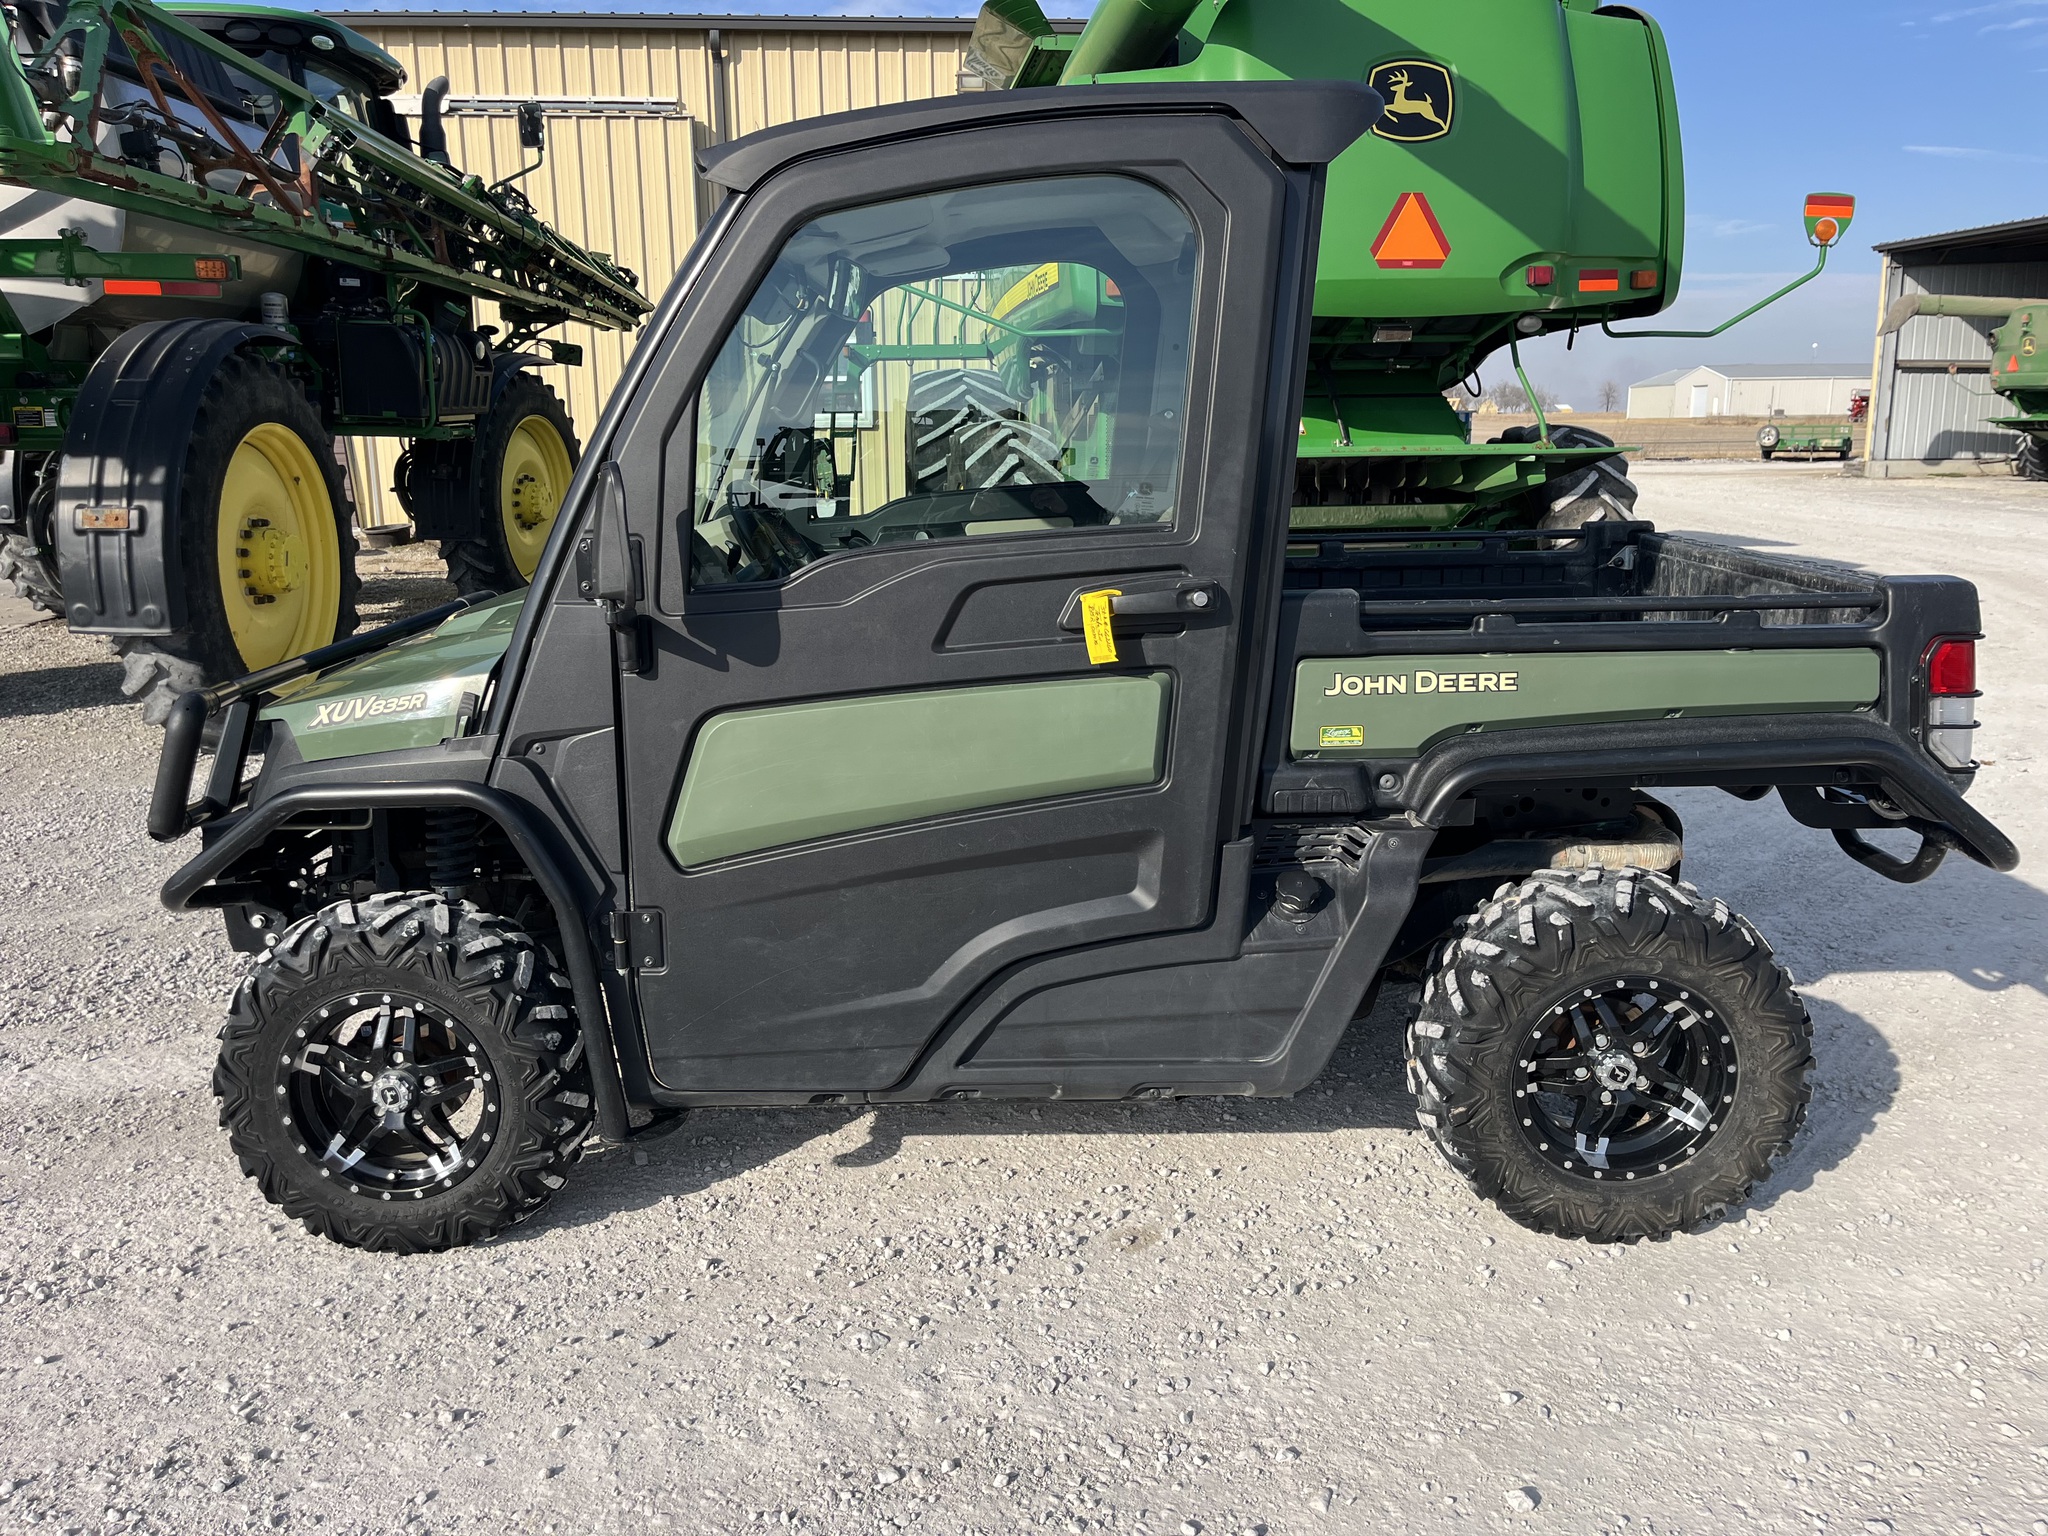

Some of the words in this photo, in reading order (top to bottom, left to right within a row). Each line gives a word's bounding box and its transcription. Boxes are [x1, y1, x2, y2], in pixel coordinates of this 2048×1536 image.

[1324, 673, 1408, 696] JOHN
[1414, 670, 1518, 693] DEERE
[306, 692, 427, 729] XUV835R
